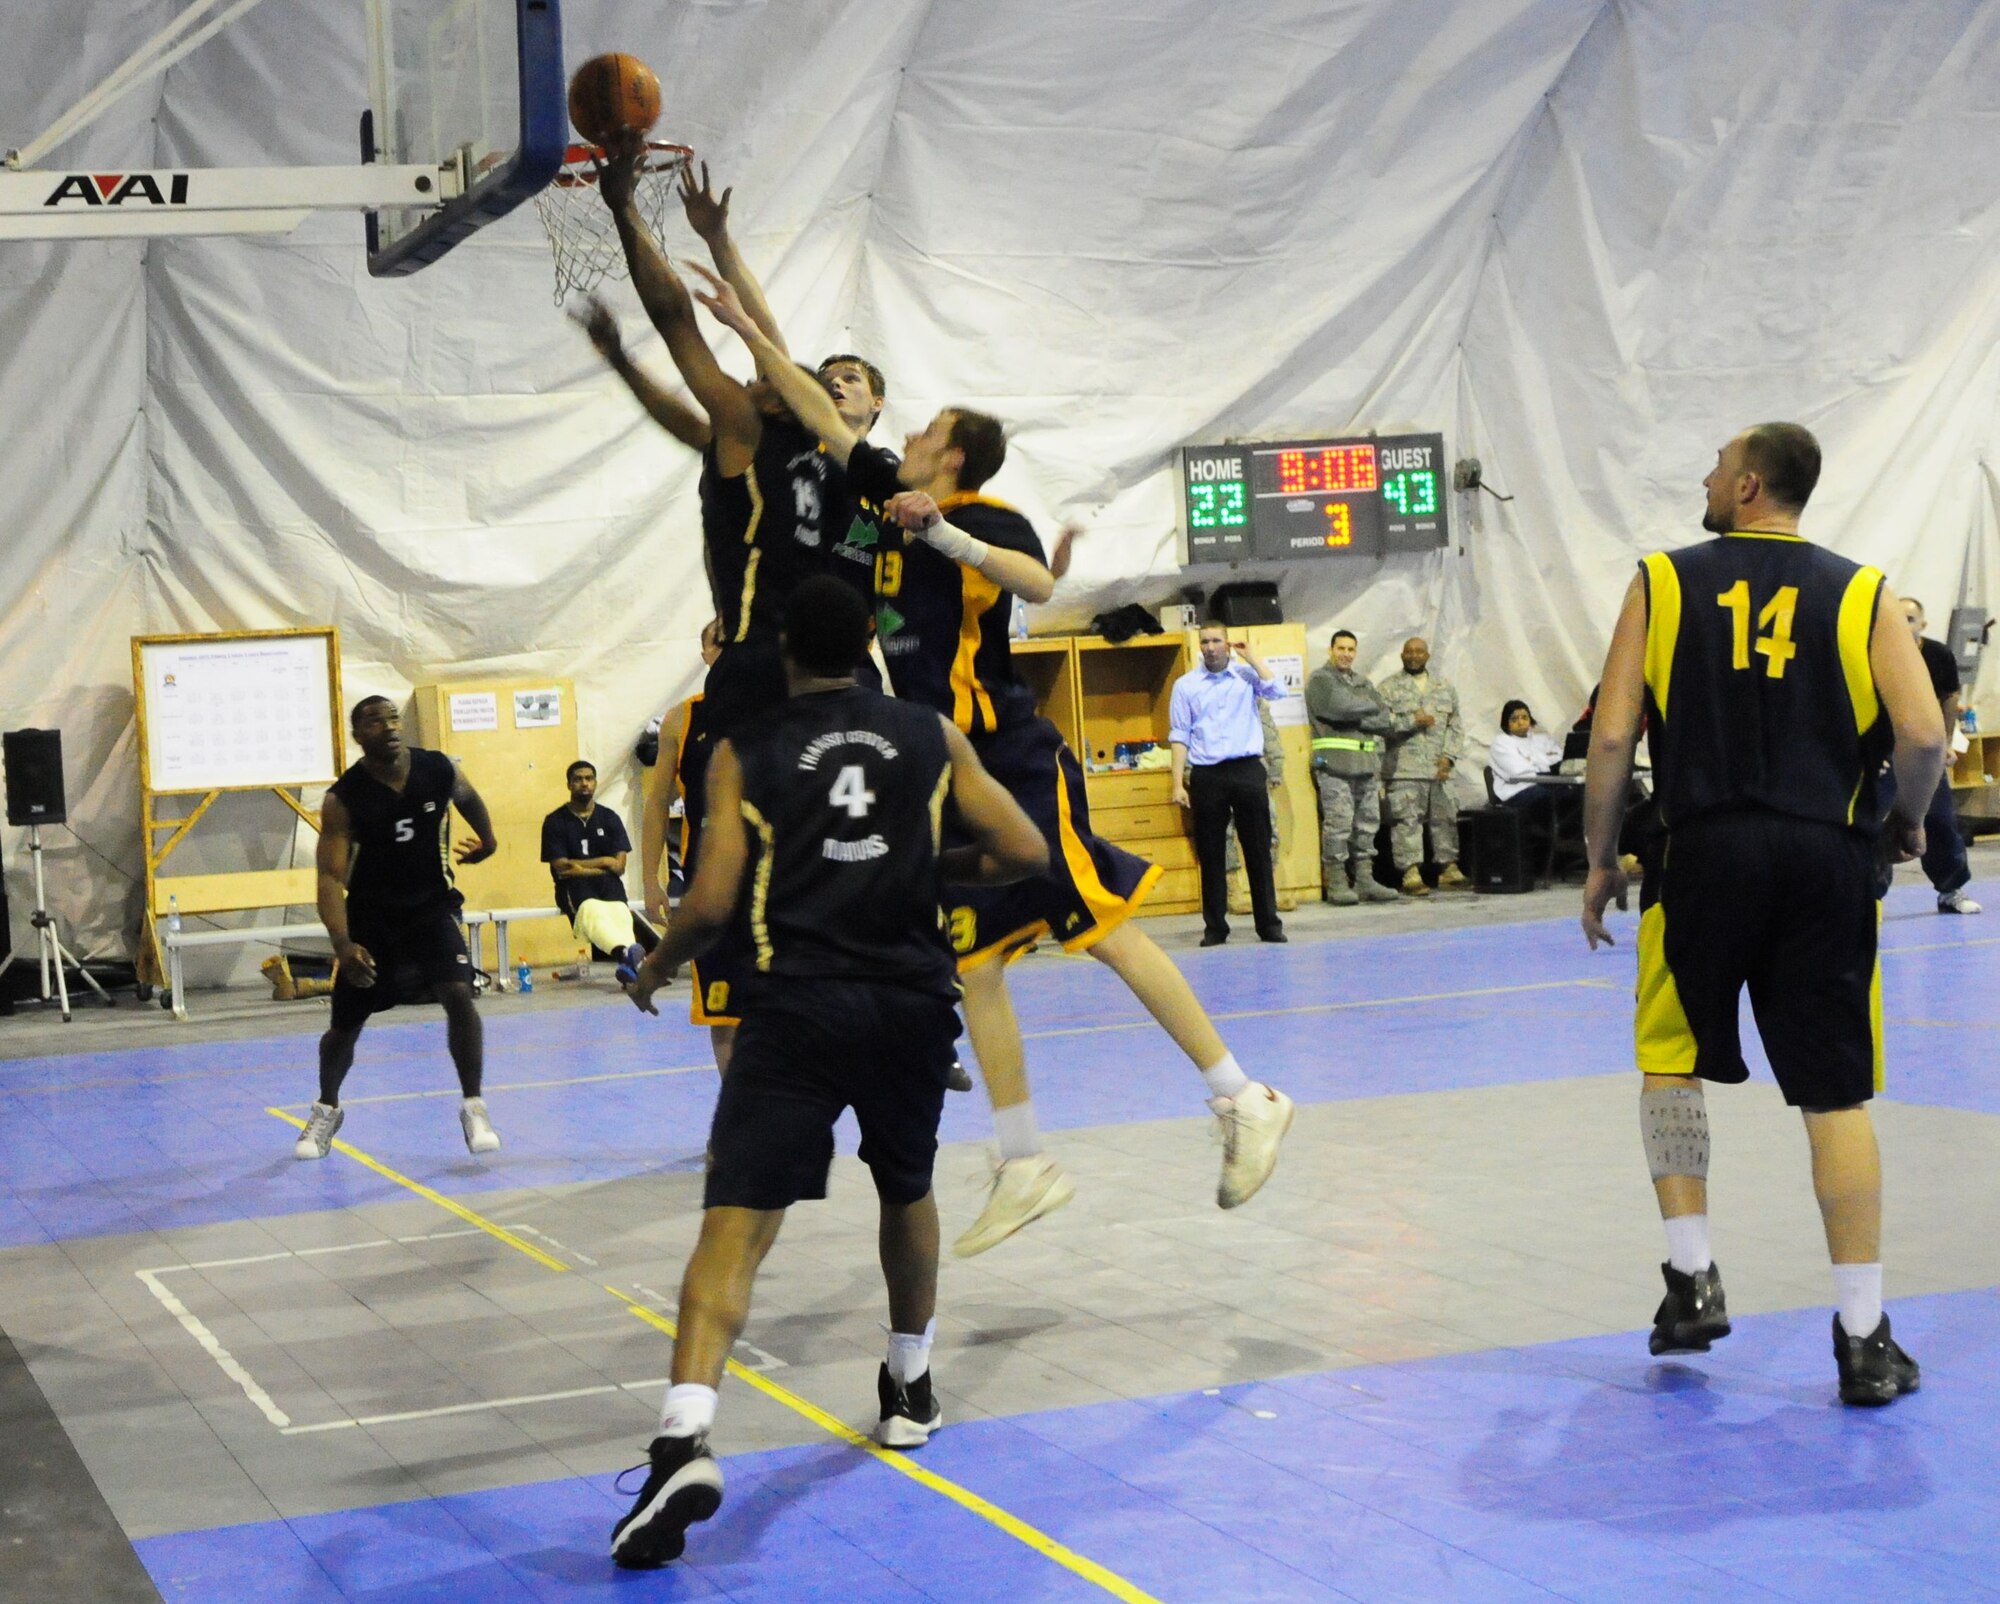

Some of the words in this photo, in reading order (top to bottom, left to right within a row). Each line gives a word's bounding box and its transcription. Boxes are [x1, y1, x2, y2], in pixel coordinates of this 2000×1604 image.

[1189, 458, 1243, 481] HOME
[1279, 448, 1375, 493] 9:06
[1381, 447, 1432, 471] GUEST
[1190, 482, 1246, 527] 22
[1384, 471, 1437, 515] 43
[1291, 536, 1325, 548] PERIOD
[1325, 503, 1351, 546] 3
[874, 550, 904, 598] 13
[1716, 579, 1799, 679] 14
[829, 764, 876, 818] 4
[395, 817, 415, 843] 5
[581, 838, 589, 856] 1
